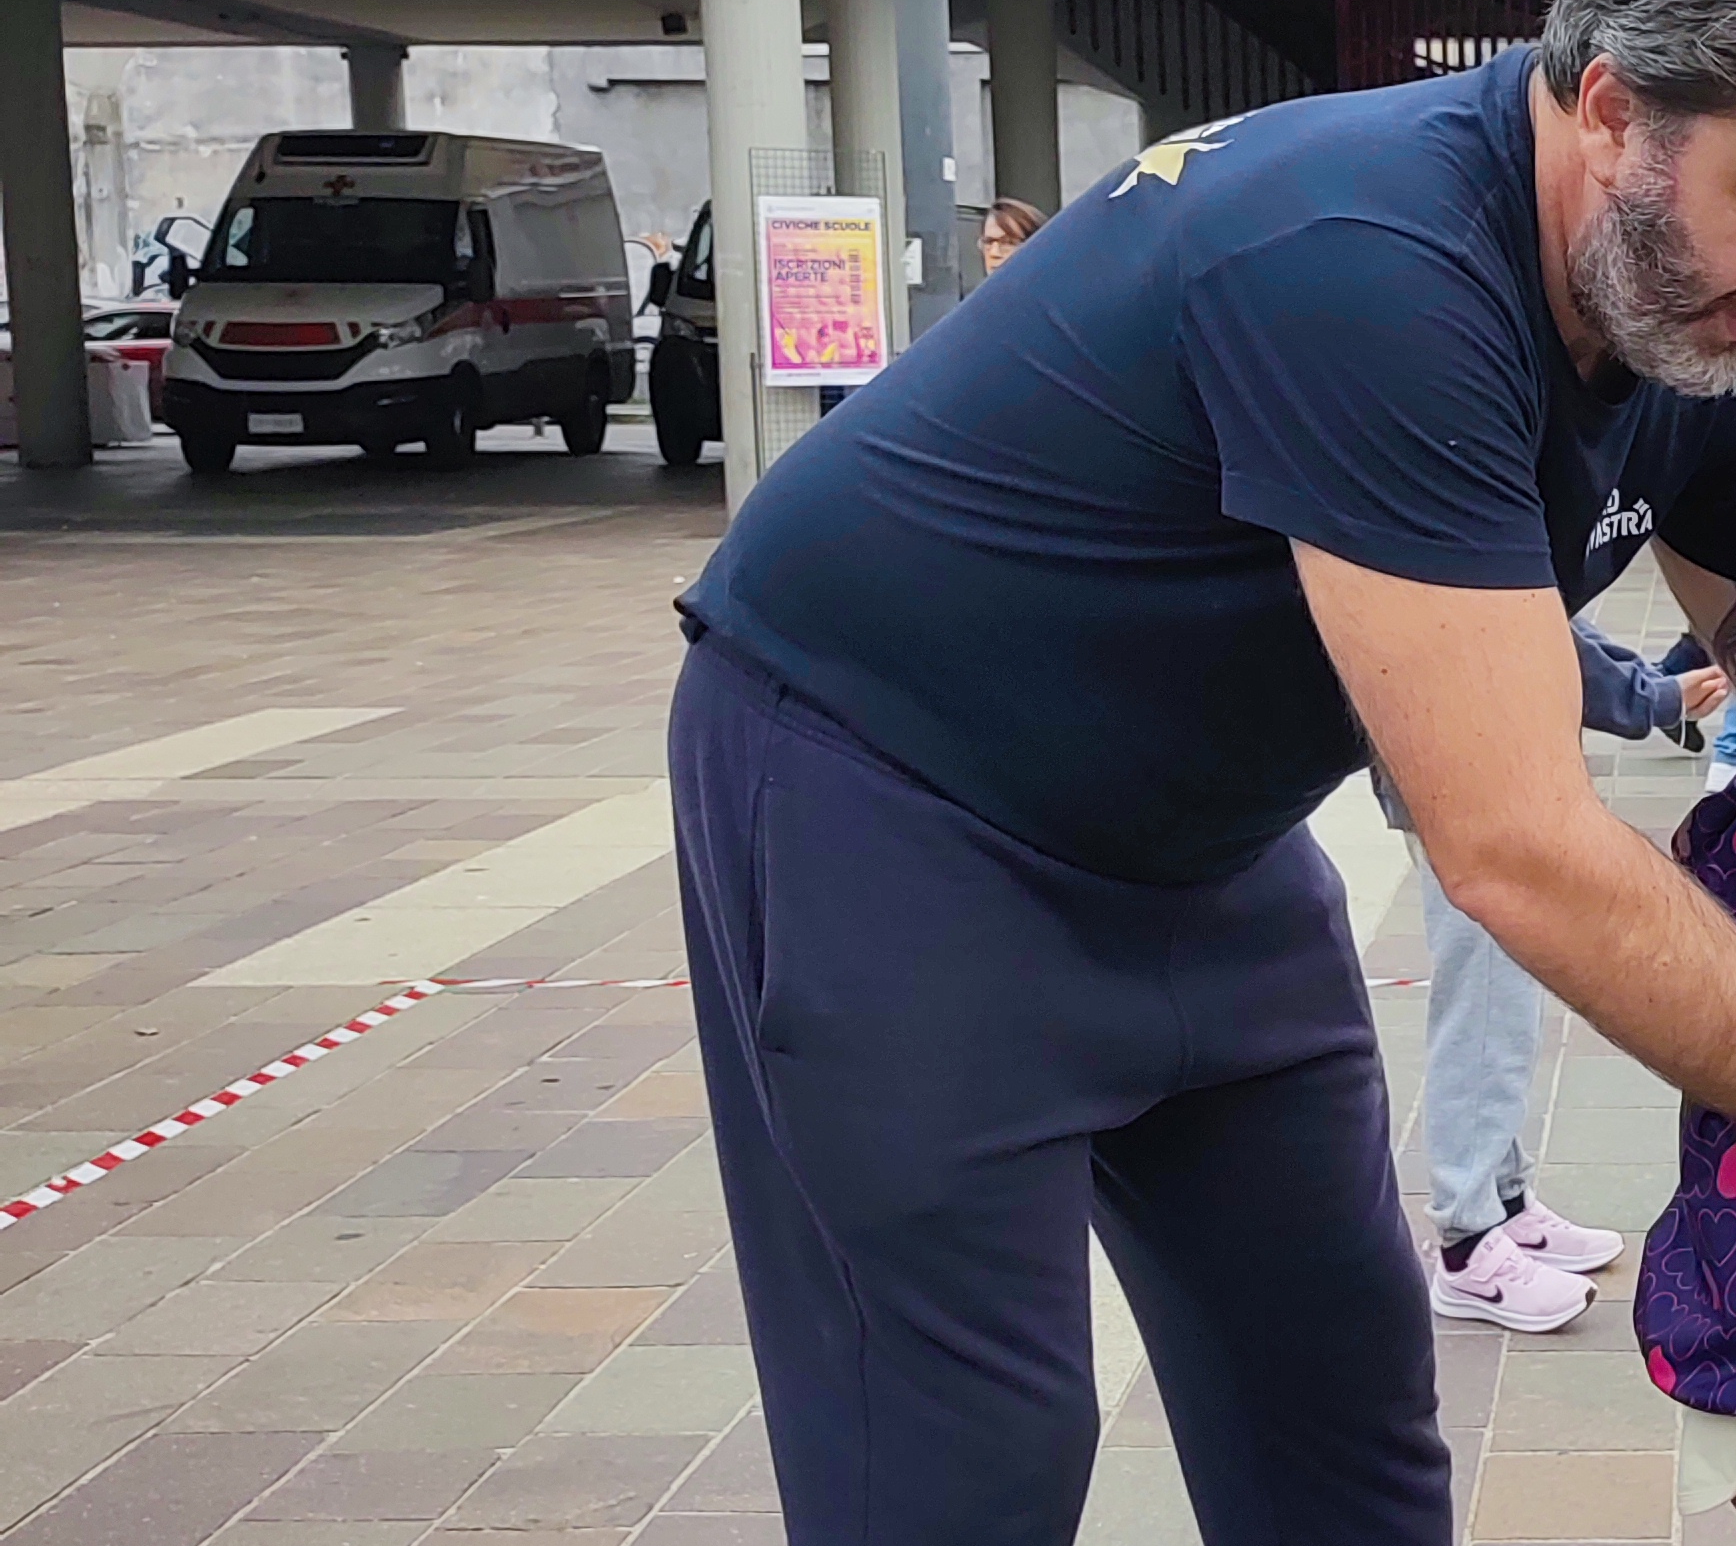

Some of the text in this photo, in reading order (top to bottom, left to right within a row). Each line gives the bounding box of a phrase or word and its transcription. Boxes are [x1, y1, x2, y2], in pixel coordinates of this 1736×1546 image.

[774, 258, 846, 271] ISCRIZIONI
[775, 271, 828, 283] APERTE
[1602, 487, 1620, 516] D
